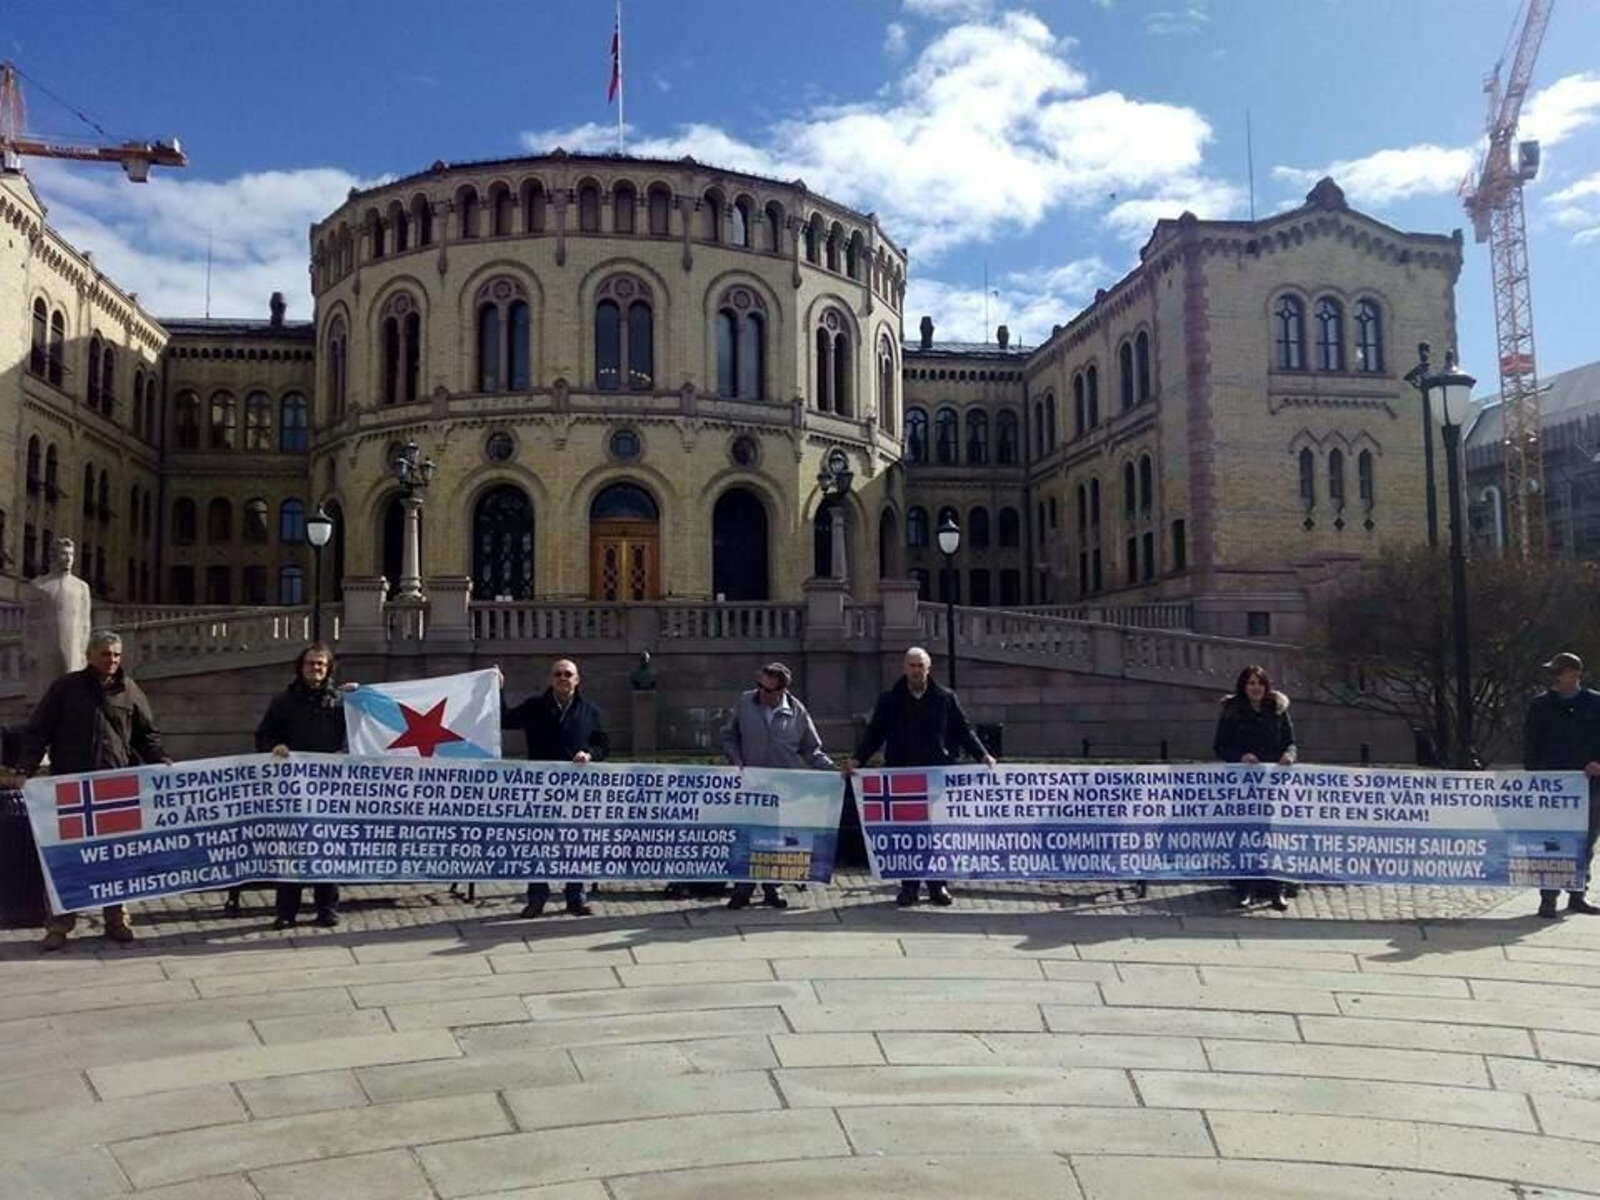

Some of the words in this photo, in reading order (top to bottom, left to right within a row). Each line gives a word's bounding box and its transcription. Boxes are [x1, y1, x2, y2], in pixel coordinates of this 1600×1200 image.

[152, 775, 171, 790] VI
[176, 765, 256, 787] SPANSKE
[262, 762, 342, 778] SJØMENN
[347, 765, 413, 781] KREVER
[419, 766, 498, 784] INNFRIDD
[503, 766, 546, 785] VÅRE
[550, 772, 663, 787] OPPARBEIDEDE
[668, 775, 742, 789] PENSJONS
[945, 773, 973, 786] NEI
[976, 773, 1000, 786] TIL
[1005, 772, 1087, 786] FORTSATT
[1095, 772, 1237, 786] DISKRIMINERING
[1242, 772, 1265, 785] AV
[1270, 772, 1348, 787] SPANSKE
[1354, 774, 1436, 789] SJØMENN
[1442, 777, 1495, 791] ETTER
[1501, 779, 1522, 792] 40
[1528, 777, 1563, 792] ÅRS
[154, 782, 272, 808] RETTIGHETER
[278, 779, 300, 795] OG
[306, 781, 408, 798] OPPREISING
[413, 784, 444, 799] FOR
[450, 785, 484, 800] DEN
[488, 786, 540, 801] URETT
[544, 788, 579, 801] SOM
[583, 789, 602, 802] ER
[607, 787, 661, 804] BEGÅTT
[666, 790, 699, 804] MOT
[702, 792, 730, 805] OSS
[735, 793, 779, 807] ETTER
[946, 789, 1023, 803] TJENESTE
[1029, 788, 1068, 802] IDEN
[1074, 788, 1143, 801] NORSKE
[1148, 786, 1289, 801] HANDELSFLÅTEN
[1294, 789, 1313, 802] VI
[1318, 790, 1385, 805] KREVER
[1391, 790, 1425, 805] VÅR
[1430, 793, 1533, 808] HISTORISKE
[1539, 795, 1582, 809] RETT
[155, 811, 178, 827] 40
[184, 804, 219, 824] ÅRS
[225, 798, 301, 819] TJENESTE
[307, 800, 311, 812] I
[316, 800, 350, 814] DEN
[355, 800, 424, 815] NORSKE
[428, 801, 567, 819] HANDELSFLÅTEN.
[571, 806, 600, 819] DET
[605, 806, 624, 819] ER
[627, 806, 647, 819] EN
[651, 806, 700, 820] SKAM!
[946, 805, 971, 817] TIL
[975, 805, 1009, 818] LIKE
[1014, 804, 1127, 817] RETTIGHETER
[1132, 804, 1166, 817] FOR
[1172, 803, 1208, 817] LIKT
[1213, 804, 1275, 817] ARBEID
[1281, 805, 1314, 818] DET
[1319, 806, 1340, 819] ER
[1346, 807, 1368, 820] EN
[1373, 807, 1429, 822] SKAM!
[80, 847, 108, 864] WE
[114, 836, 191, 859] DEMAND
[195, 827, 239, 846] THAT
[242, 823, 308, 840] NORWAY
[312, 824, 359, 839] GIVES
[364, 825, 395, 838] THE
[400, 825, 457, 840] RIGTHS
[461, 826, 482, 839] TO
[486, 827, 553, 841] PENSION
[559, 827, 579, 842] TO
[583, 828, 610, 842] THE
[614, 829, 675, 843] SPANISH
[678, 829, 736, 843] SAILORS
[208, 844, 247, 863] WHO
[252, 841, 319, 856] WORKED
[323, 842, 347, 856] ON
[351, 842, 396, 856] THEIR
[401, 843, 447, 857] FLEET
[451, 844, 482, 858] FOR
[485, 844, 506, 859] 40
[511, 844, 560, 858] YEARS
[564, 845, 599, 858] TIME
[602, 845, 633, 859] FOR
[637, 845, 699, 859] REDRESS
[702, 845, 730, 859] FOR
[892, 834, 912, 850] TO
[918, 832, 1042, 850] DISCRIMINATION
[1046, 832, 1140, 849] COMMITTED
[1144, 832, 1162, 849] BY
[1168, 831, 1236, 849] NORWAY
[1240, 831, 1309, 850] AGAINST
[1312, 835, 1342, 852] THE
[1347, 837, 1415, 854] SPANISH
[1419, 838, 1487, 856] SAILORS
[90, 883, 124, 899] THE
[129, 868, 231, 894] HISTORICAL
[235, 858, 307, 877] INJUSTICE
[311, 859, 397, 875] COMMITED
[401, 860, 420, 875] BY
[426, 860, 494, 875] NORWAY
[534, 861, 546, 875] A
[550, 861, 601, 875] SHAME
[605, 861, 627, 875] ON
[630, 861, 661, 875] YOU
[664, 861, 729, 875] NORWAY.
[928, 856, 947, 873] 40
[950, 855, 1005, 872] YEARS.
[1009, 855, 1058, 875] EQUAL
[1062, 854, 1116, 873] WORK,
[1120, 853, 1169, 874] EQUAL
[1174, 853, 1235, 870] RIGTHS.
[1240, 853, 1268, 870] IT'S
[1272, 855, 1283, 869] A
[1287, 855, 1343, 873] SHAME
[1347, 857, 1371, 874] ON
[1374, 859, 1410, 876] YOU
[1413, 860, 1487, 879] NORWAY.
